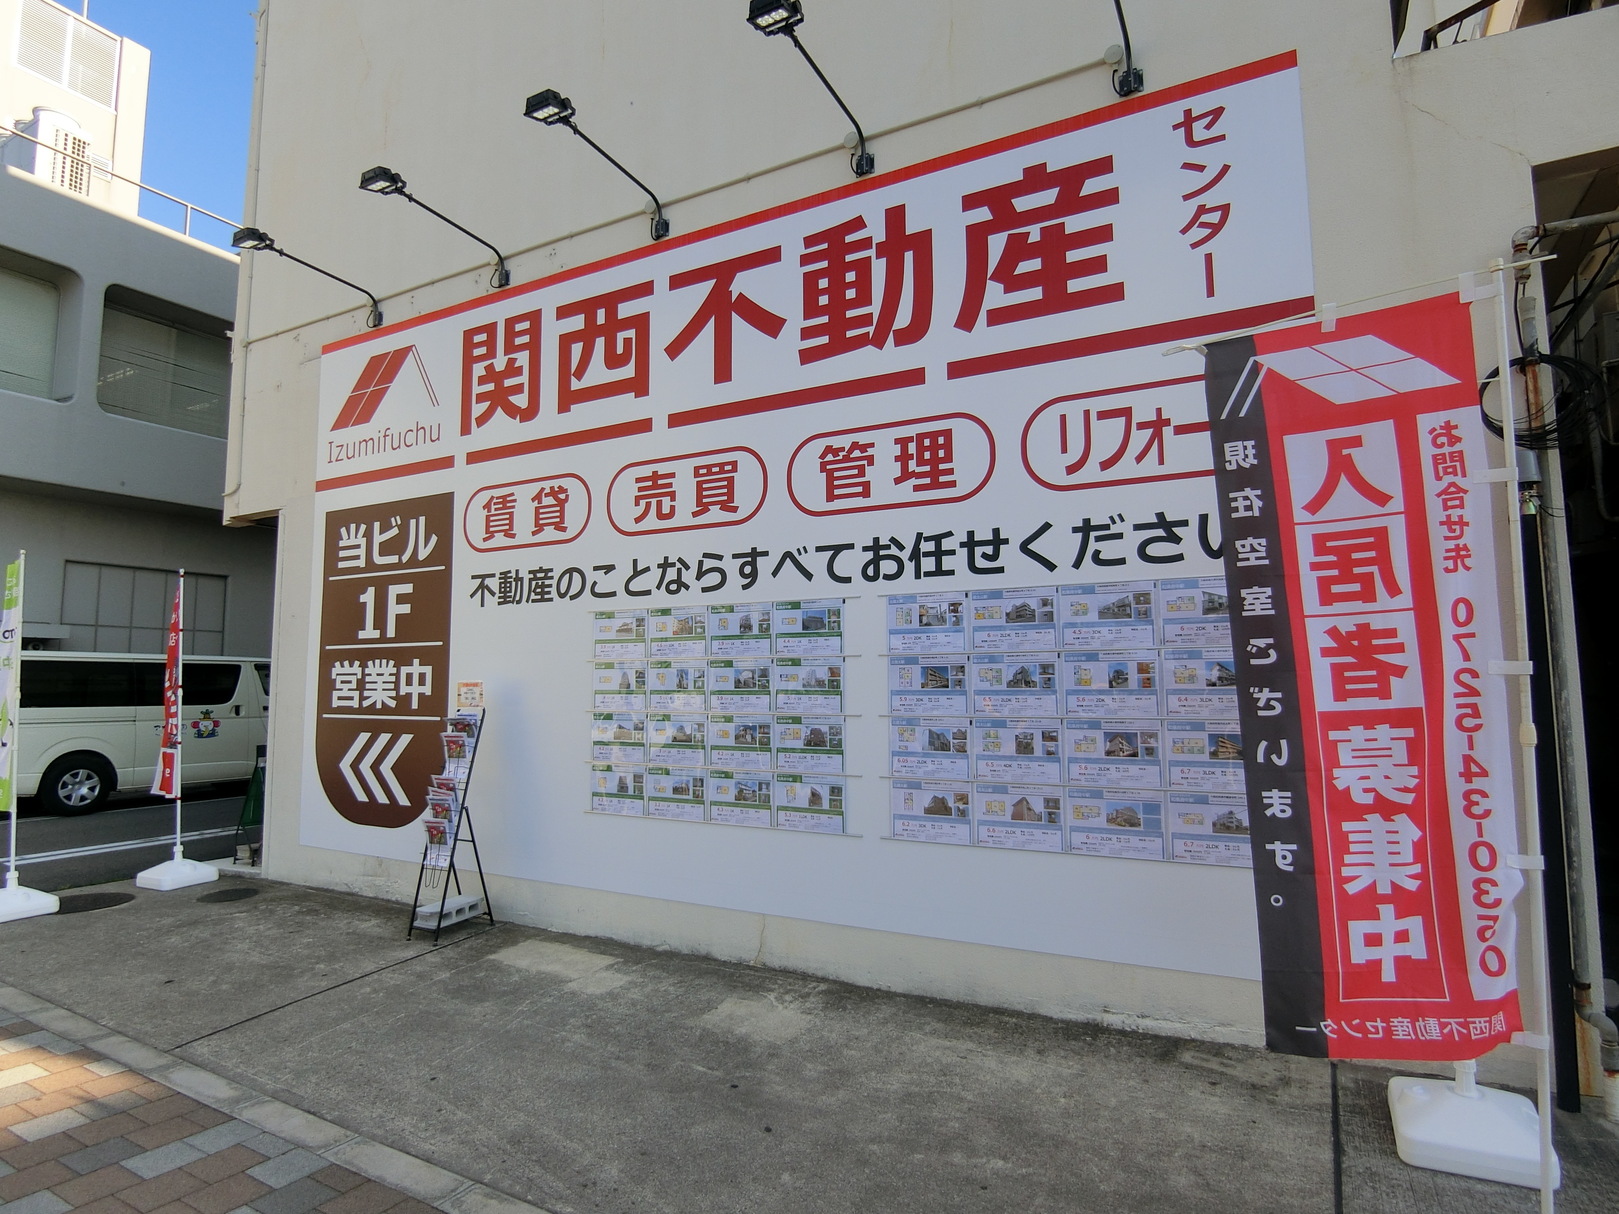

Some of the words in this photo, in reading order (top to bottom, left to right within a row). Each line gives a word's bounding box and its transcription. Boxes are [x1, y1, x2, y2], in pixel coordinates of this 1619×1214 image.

[459, 154, 1126, 437] 関西不動産
[1172, 104, 1231, 299] センター
[327, 420, 441, 464] Izumifuchu
[819, 428, 957, 503] 管理
[482, 485, 570, 542] 賃貸
[634, 459, 740, 525] 売買
[337, 515, 438, 569] 当ビル
[358, 583, 414, 639] 1F
[331, 658, 433, 710] 営業中
